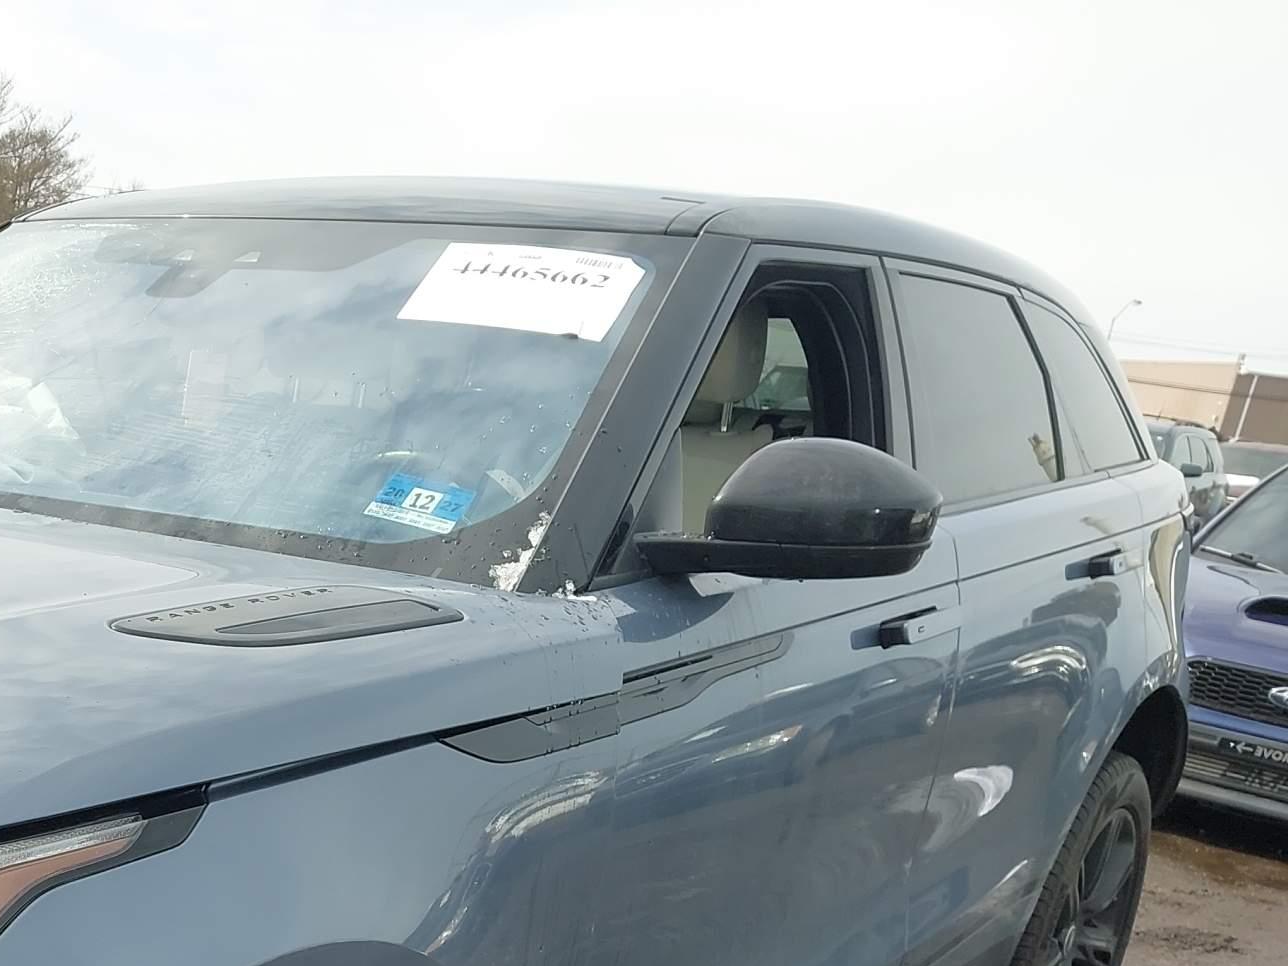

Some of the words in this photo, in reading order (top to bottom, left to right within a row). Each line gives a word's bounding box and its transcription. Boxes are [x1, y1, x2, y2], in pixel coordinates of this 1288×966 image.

[452, 260, 611, 288] 44465662
[408, 492, 436, 510] 12
[439, 500, 464, 513] 27
[247, 587, 333, 605] ROVER
